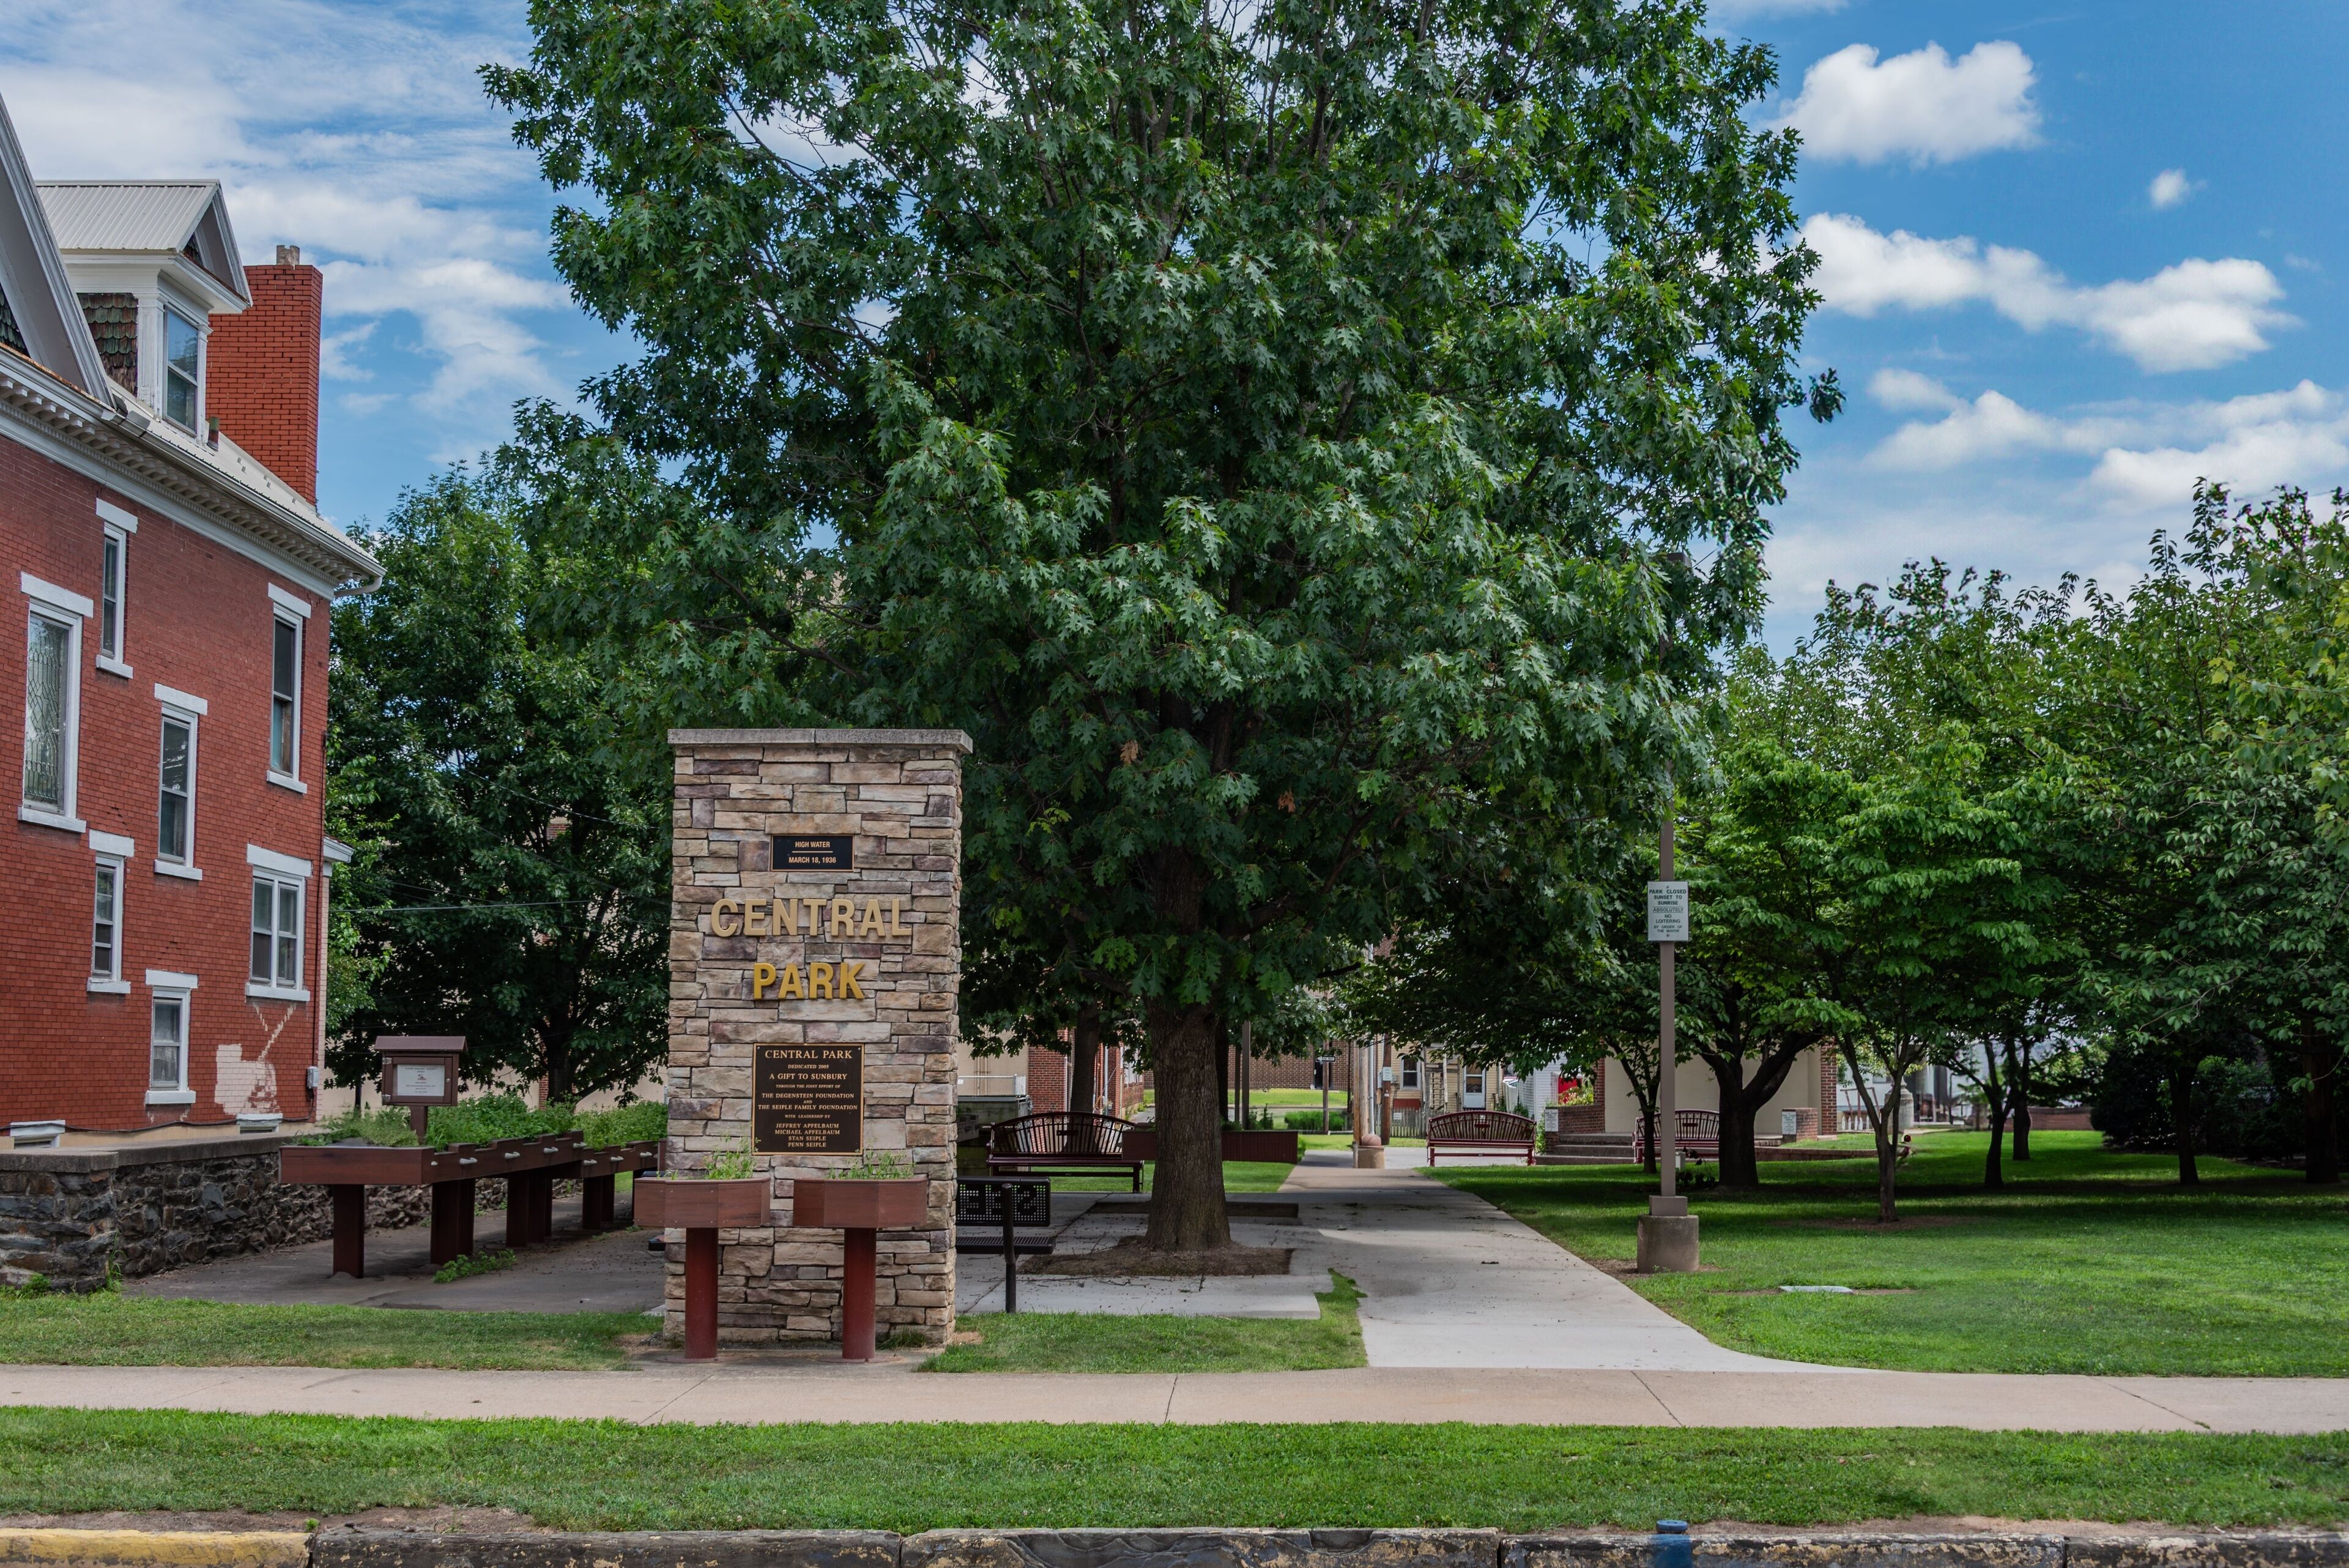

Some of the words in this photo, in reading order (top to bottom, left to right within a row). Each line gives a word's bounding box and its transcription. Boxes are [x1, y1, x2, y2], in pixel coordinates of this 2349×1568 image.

[811, 856, 821, 864] 18,
[710, 898, 912, 937] CENTRAL
[753, 962, 866, 1000] PARK
[765, 1050, 818, 1058] CENTRAL
[823, 1050, 853, 1058] PARK
